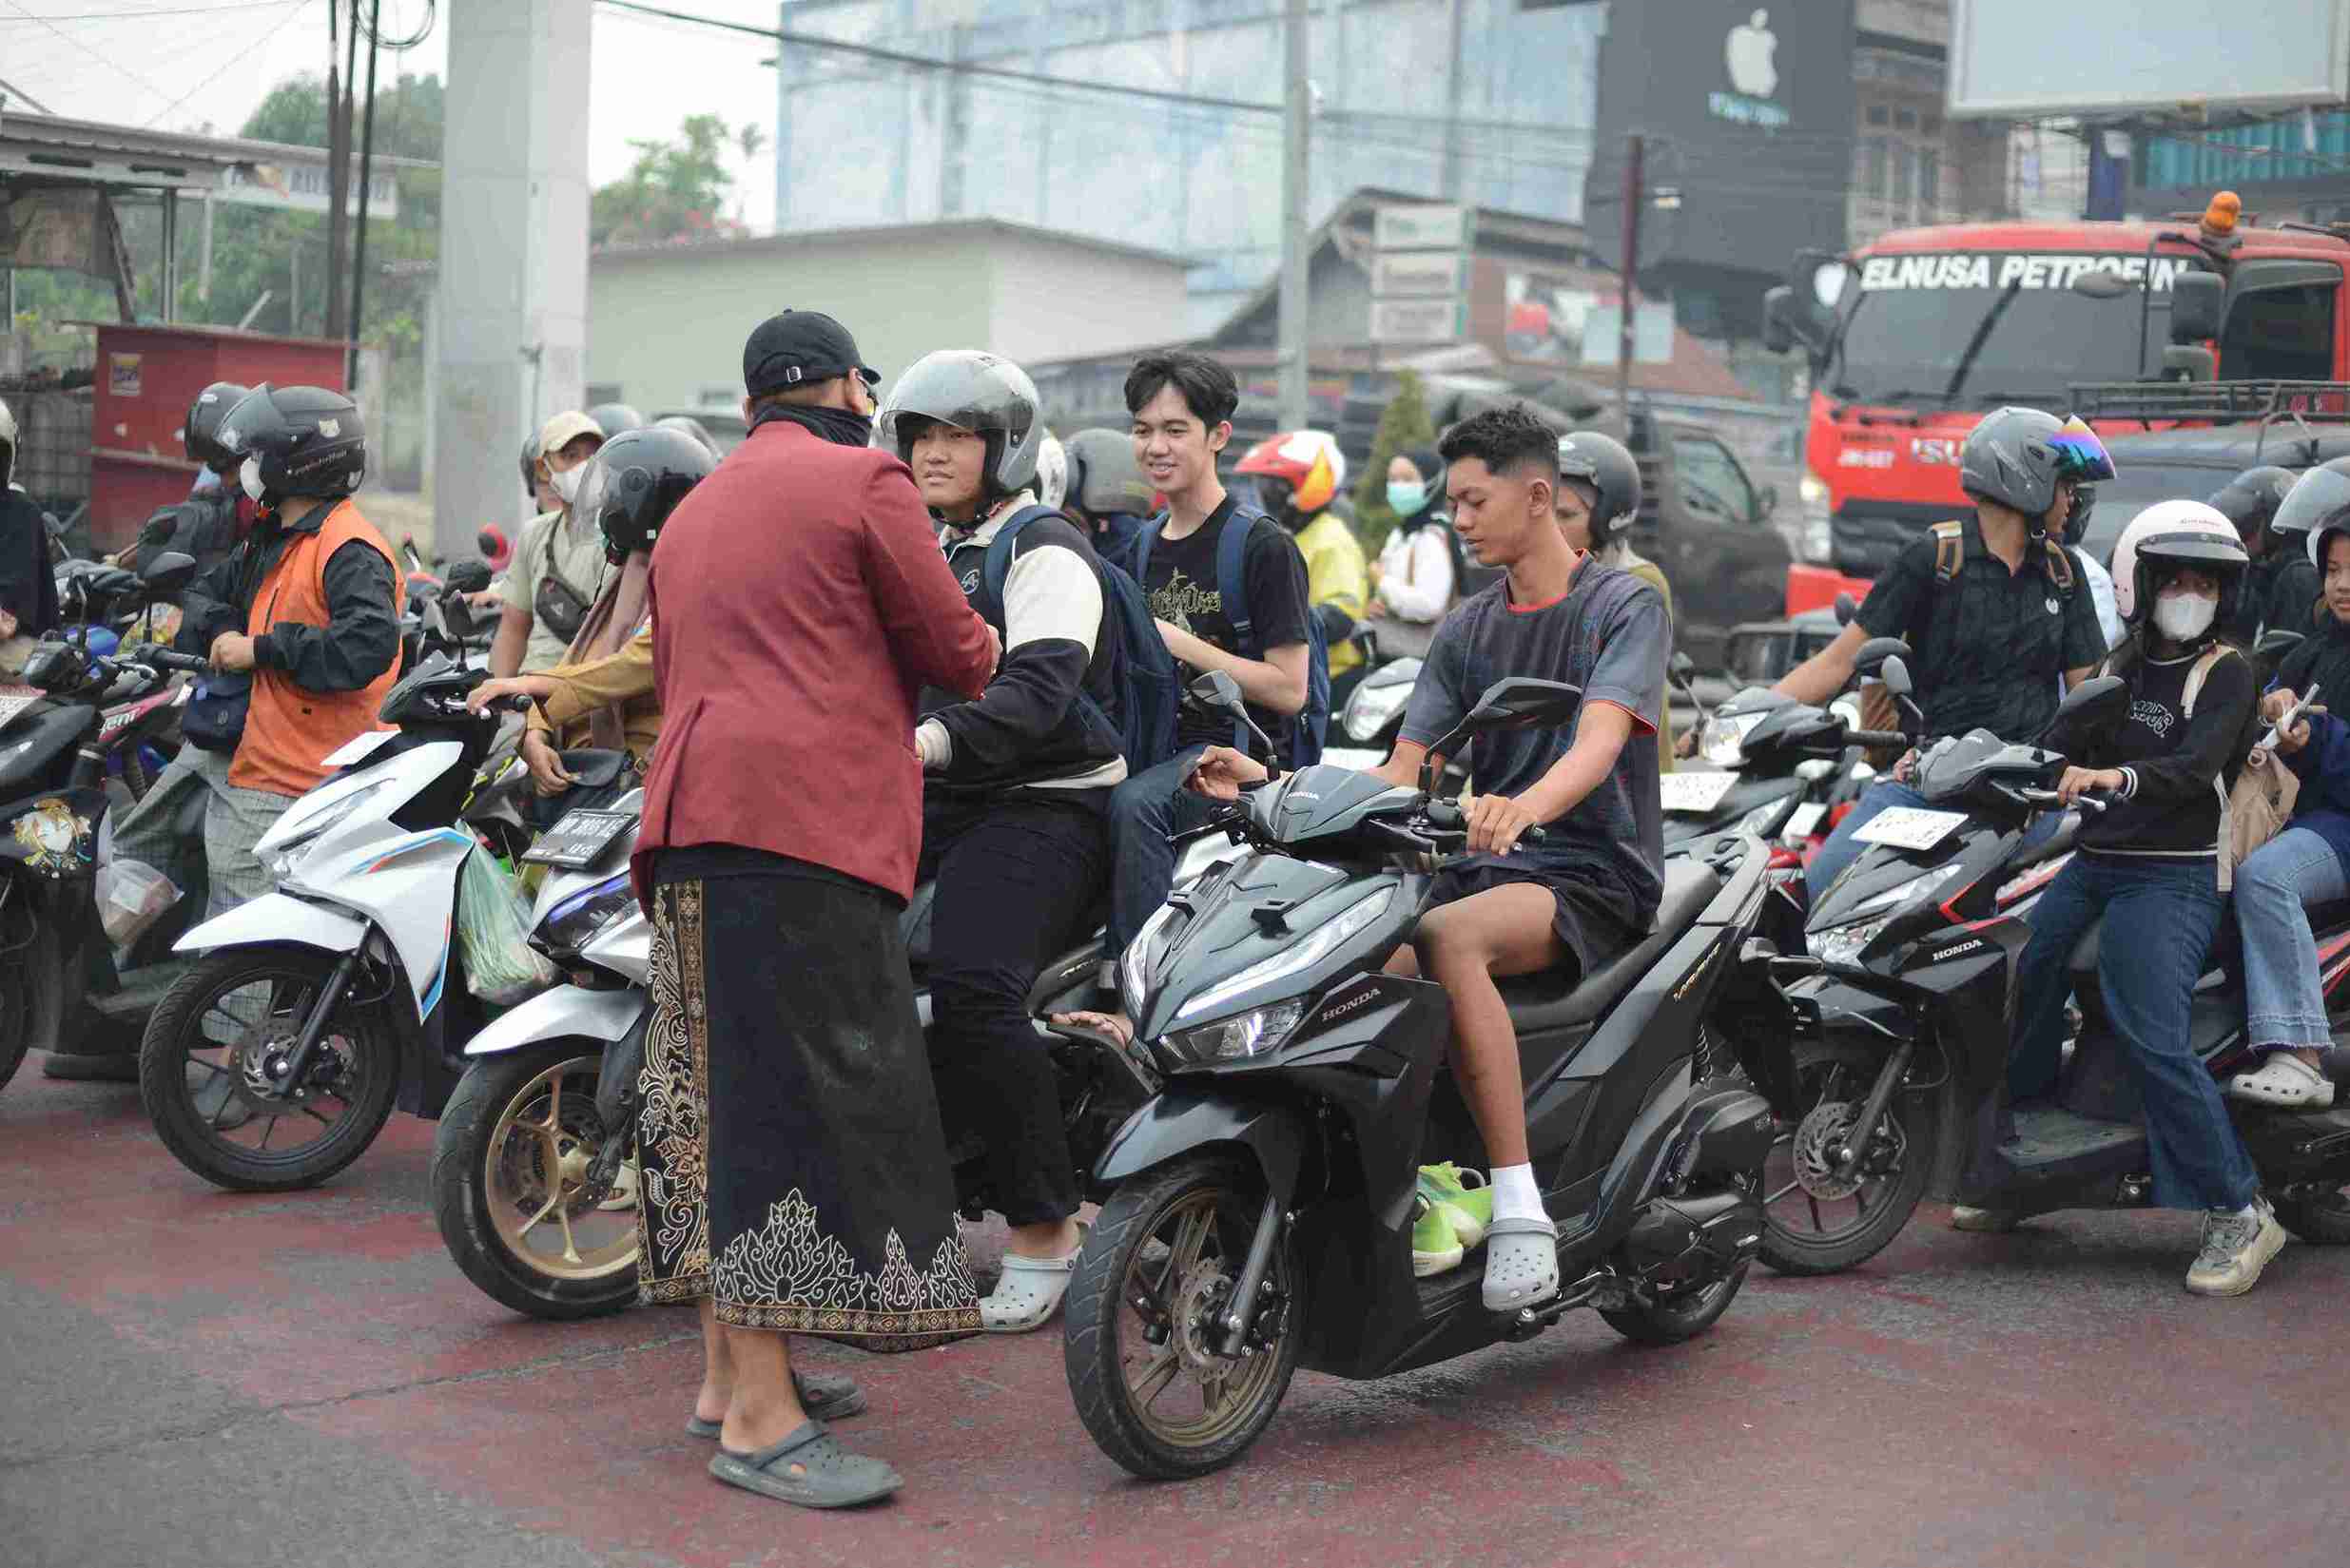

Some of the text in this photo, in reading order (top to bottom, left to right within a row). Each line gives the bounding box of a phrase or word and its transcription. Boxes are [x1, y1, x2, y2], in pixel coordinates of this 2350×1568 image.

[1861, 255, 1991, 289] ELNUSA
[1932, 939, 1984, 960] HONDA
[1322, 987, 1382, 1021] HONDA
